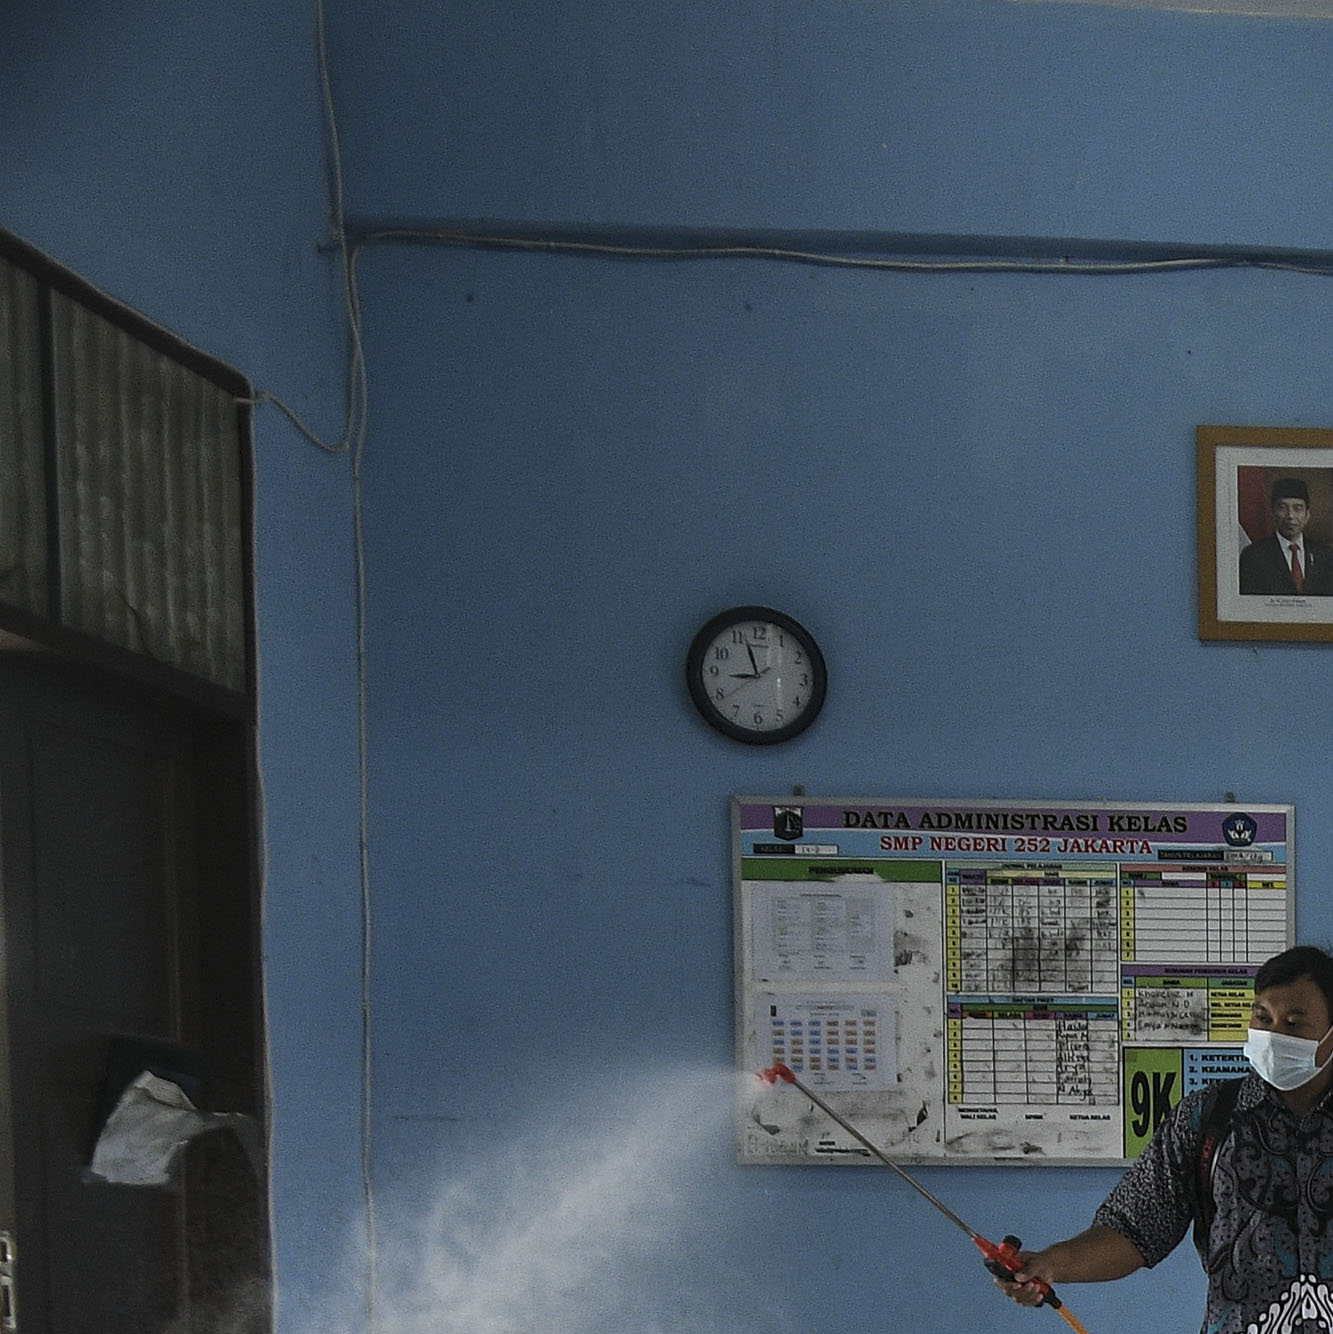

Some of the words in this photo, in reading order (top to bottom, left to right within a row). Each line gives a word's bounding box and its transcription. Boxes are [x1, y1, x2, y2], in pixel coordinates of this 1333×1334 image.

[732, 630, 743, 644] 11
[753, 627, 766, 640] 12
[715, 646, 729, 660] 10
[795, 650, 802, 665] 2
[709, 665, 719, 677] 9
[800, 673, 808, 687] 3
[715, 688, 725, 701] 8
[792, 696, 800, 707] 4
[732, 704, 740, 718] 7
[776, 709, 784, 722] 5
[753, 712, 763, 725] 6
[844, 811, 912, 829] DATA
[918, 812, 1100, 832] ADMINISTRASI
[1107, 815, 1188, 833] KELAS
[880, 836, 923, 851] SMP
[930, 837, 1008, 852] NEGERI
[1014, 837, 1050, 853] 252
[1057, 839, 1153, 854] JAKARTA
[1189, 1054, 1198, 1062] 1.
[1201, 1054, 1249, 1062] KETERTIB
[1189, 1078, 1198, 1086] 3.
[1131, 1070, 1177, 1138] 9K
